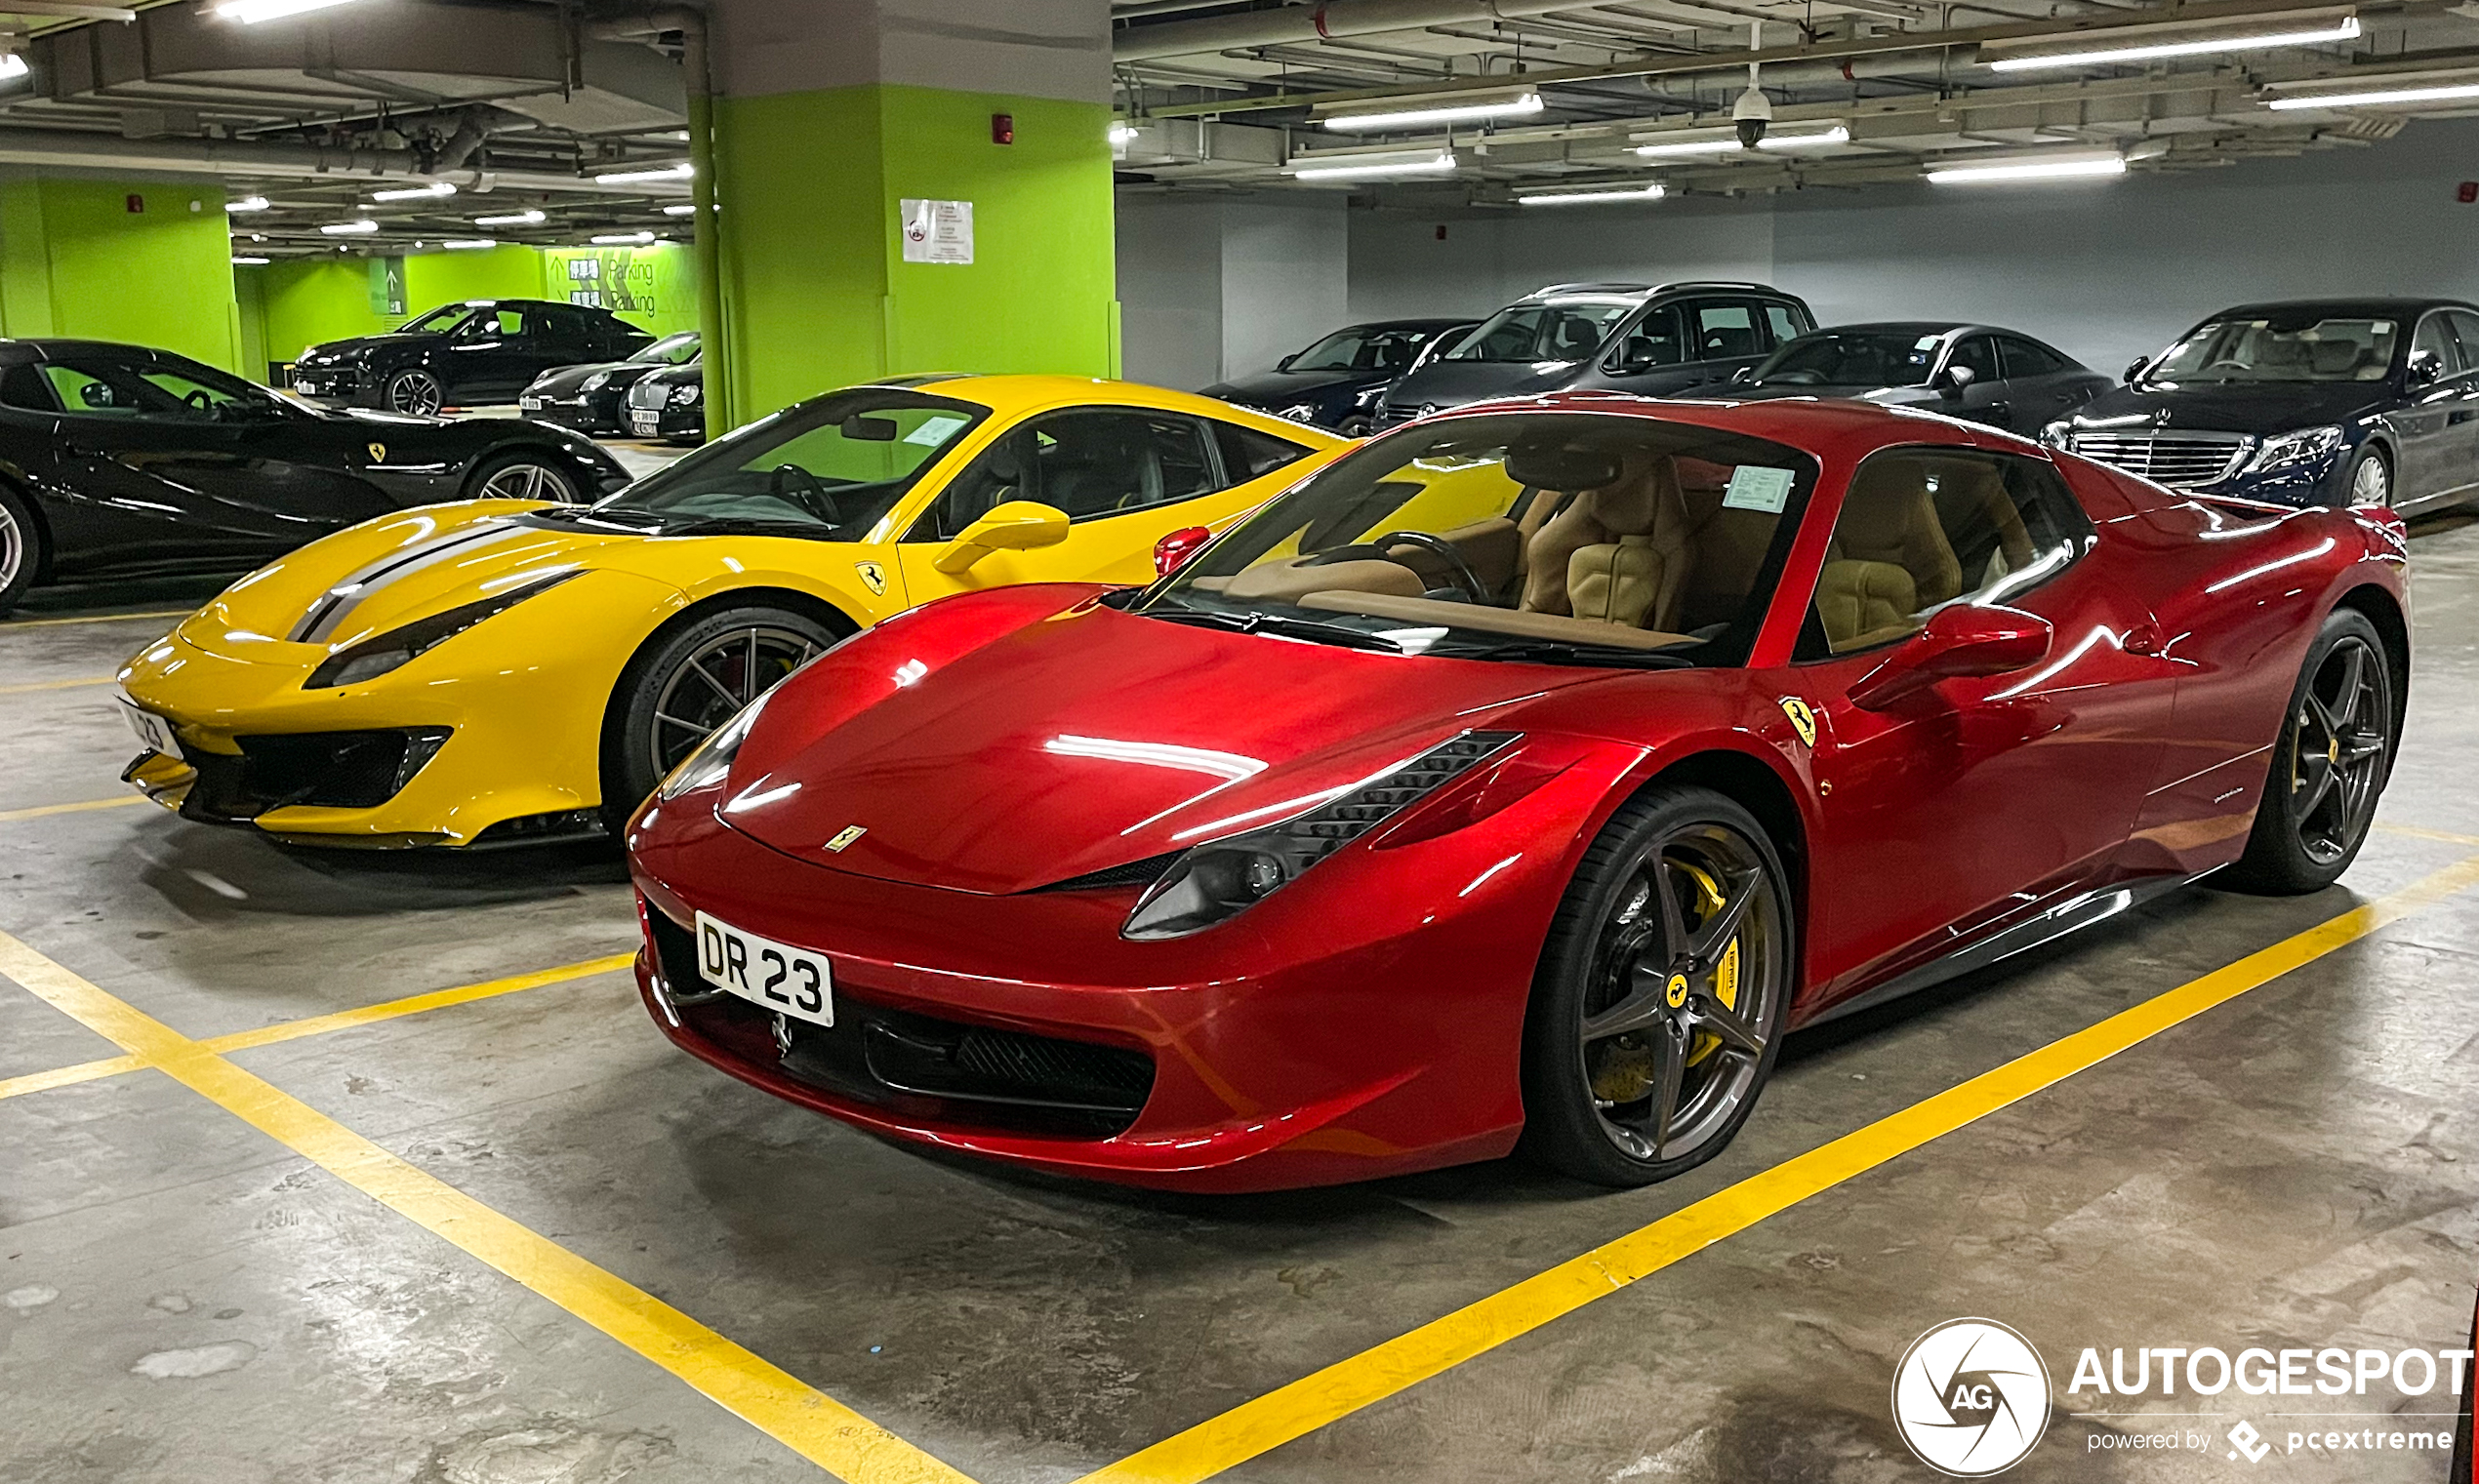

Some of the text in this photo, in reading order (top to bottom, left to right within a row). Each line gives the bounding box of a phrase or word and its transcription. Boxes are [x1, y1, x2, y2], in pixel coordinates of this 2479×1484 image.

[609, 258, 653, 286] Parking
[611, 290, 655, 318] Parking
[704, 922, 823, 1014] DR 23
